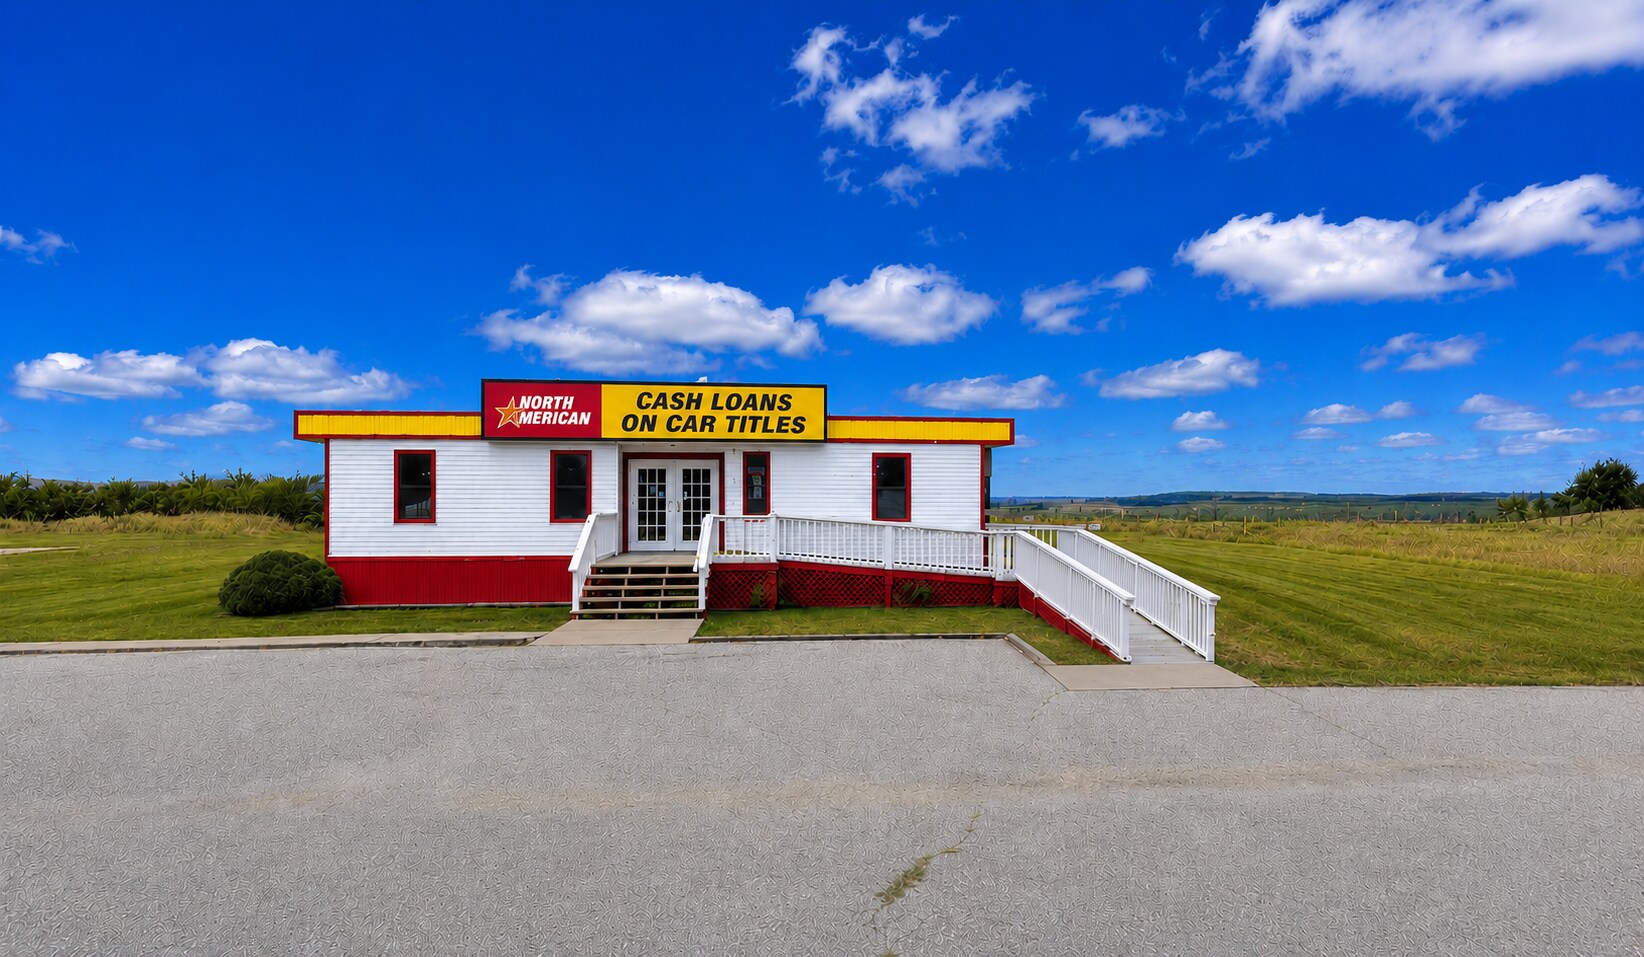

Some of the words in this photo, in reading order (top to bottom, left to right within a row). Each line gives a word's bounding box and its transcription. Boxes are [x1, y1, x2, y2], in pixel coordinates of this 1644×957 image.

[519, 395, 575, 410] NORTH
[636, 391, 704, 410] CASH
[710, 392, 793, 411] LOANS
[621, 414, 658, 433] ON
[665, 414, 717, 433] CAR
[725, 415, 807, 434] TITLES
